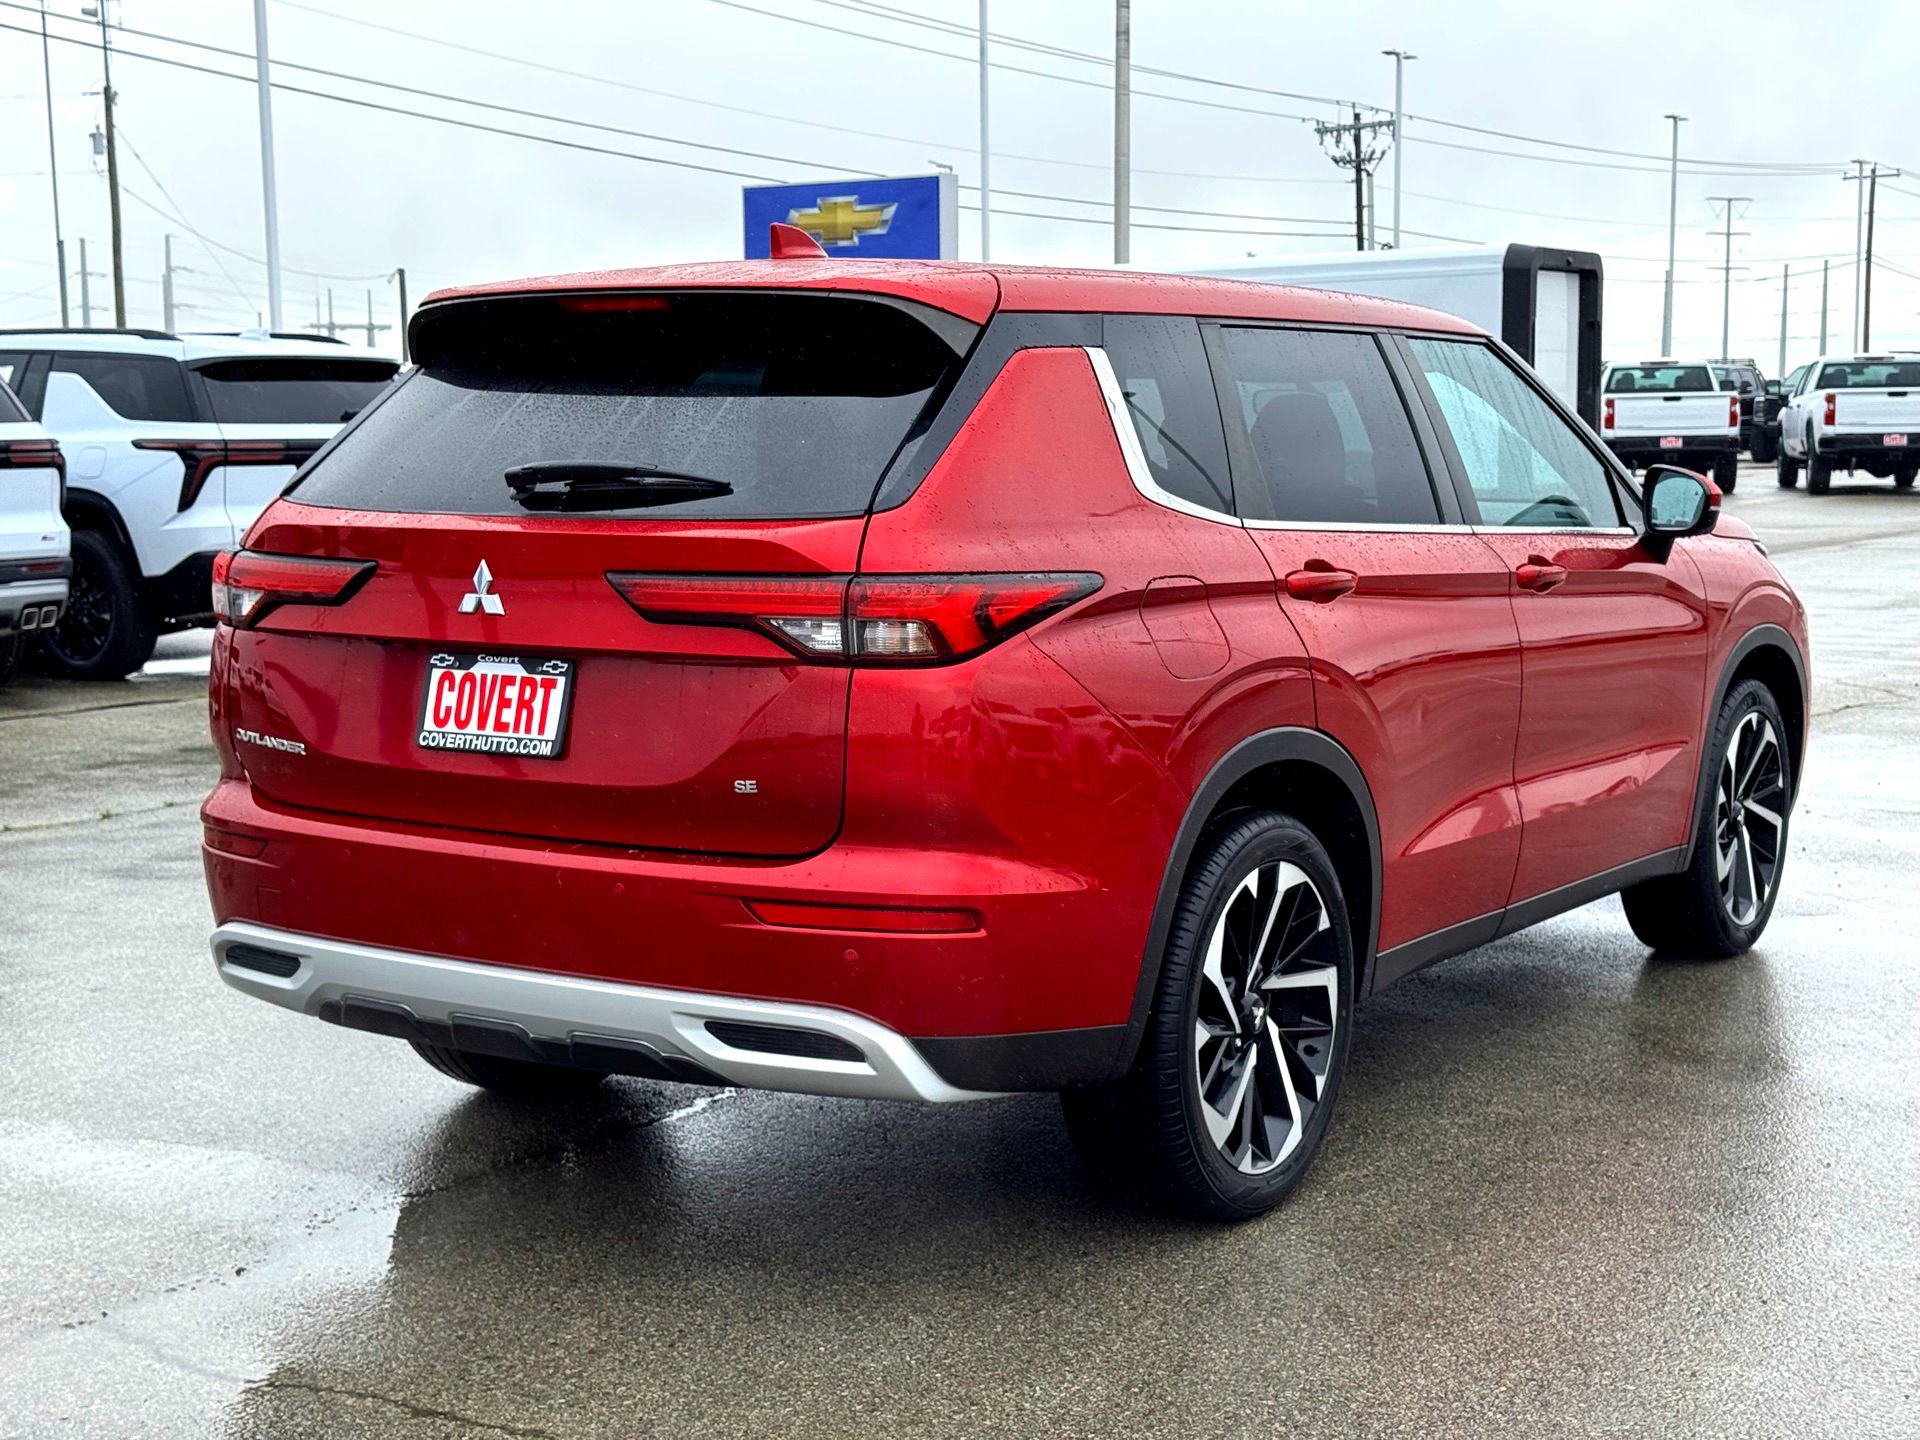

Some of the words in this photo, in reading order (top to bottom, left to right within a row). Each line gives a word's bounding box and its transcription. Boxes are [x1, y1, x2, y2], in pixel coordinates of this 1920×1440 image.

[477, 654, 520, 664] Covert
[433, 670, 558, 736] COVERT
[236, 728, 307, 756] OUTLANDER
[419, 731, 553, 756] COVERTHUTTO.COM
[734, 780, 758, 794] SE
